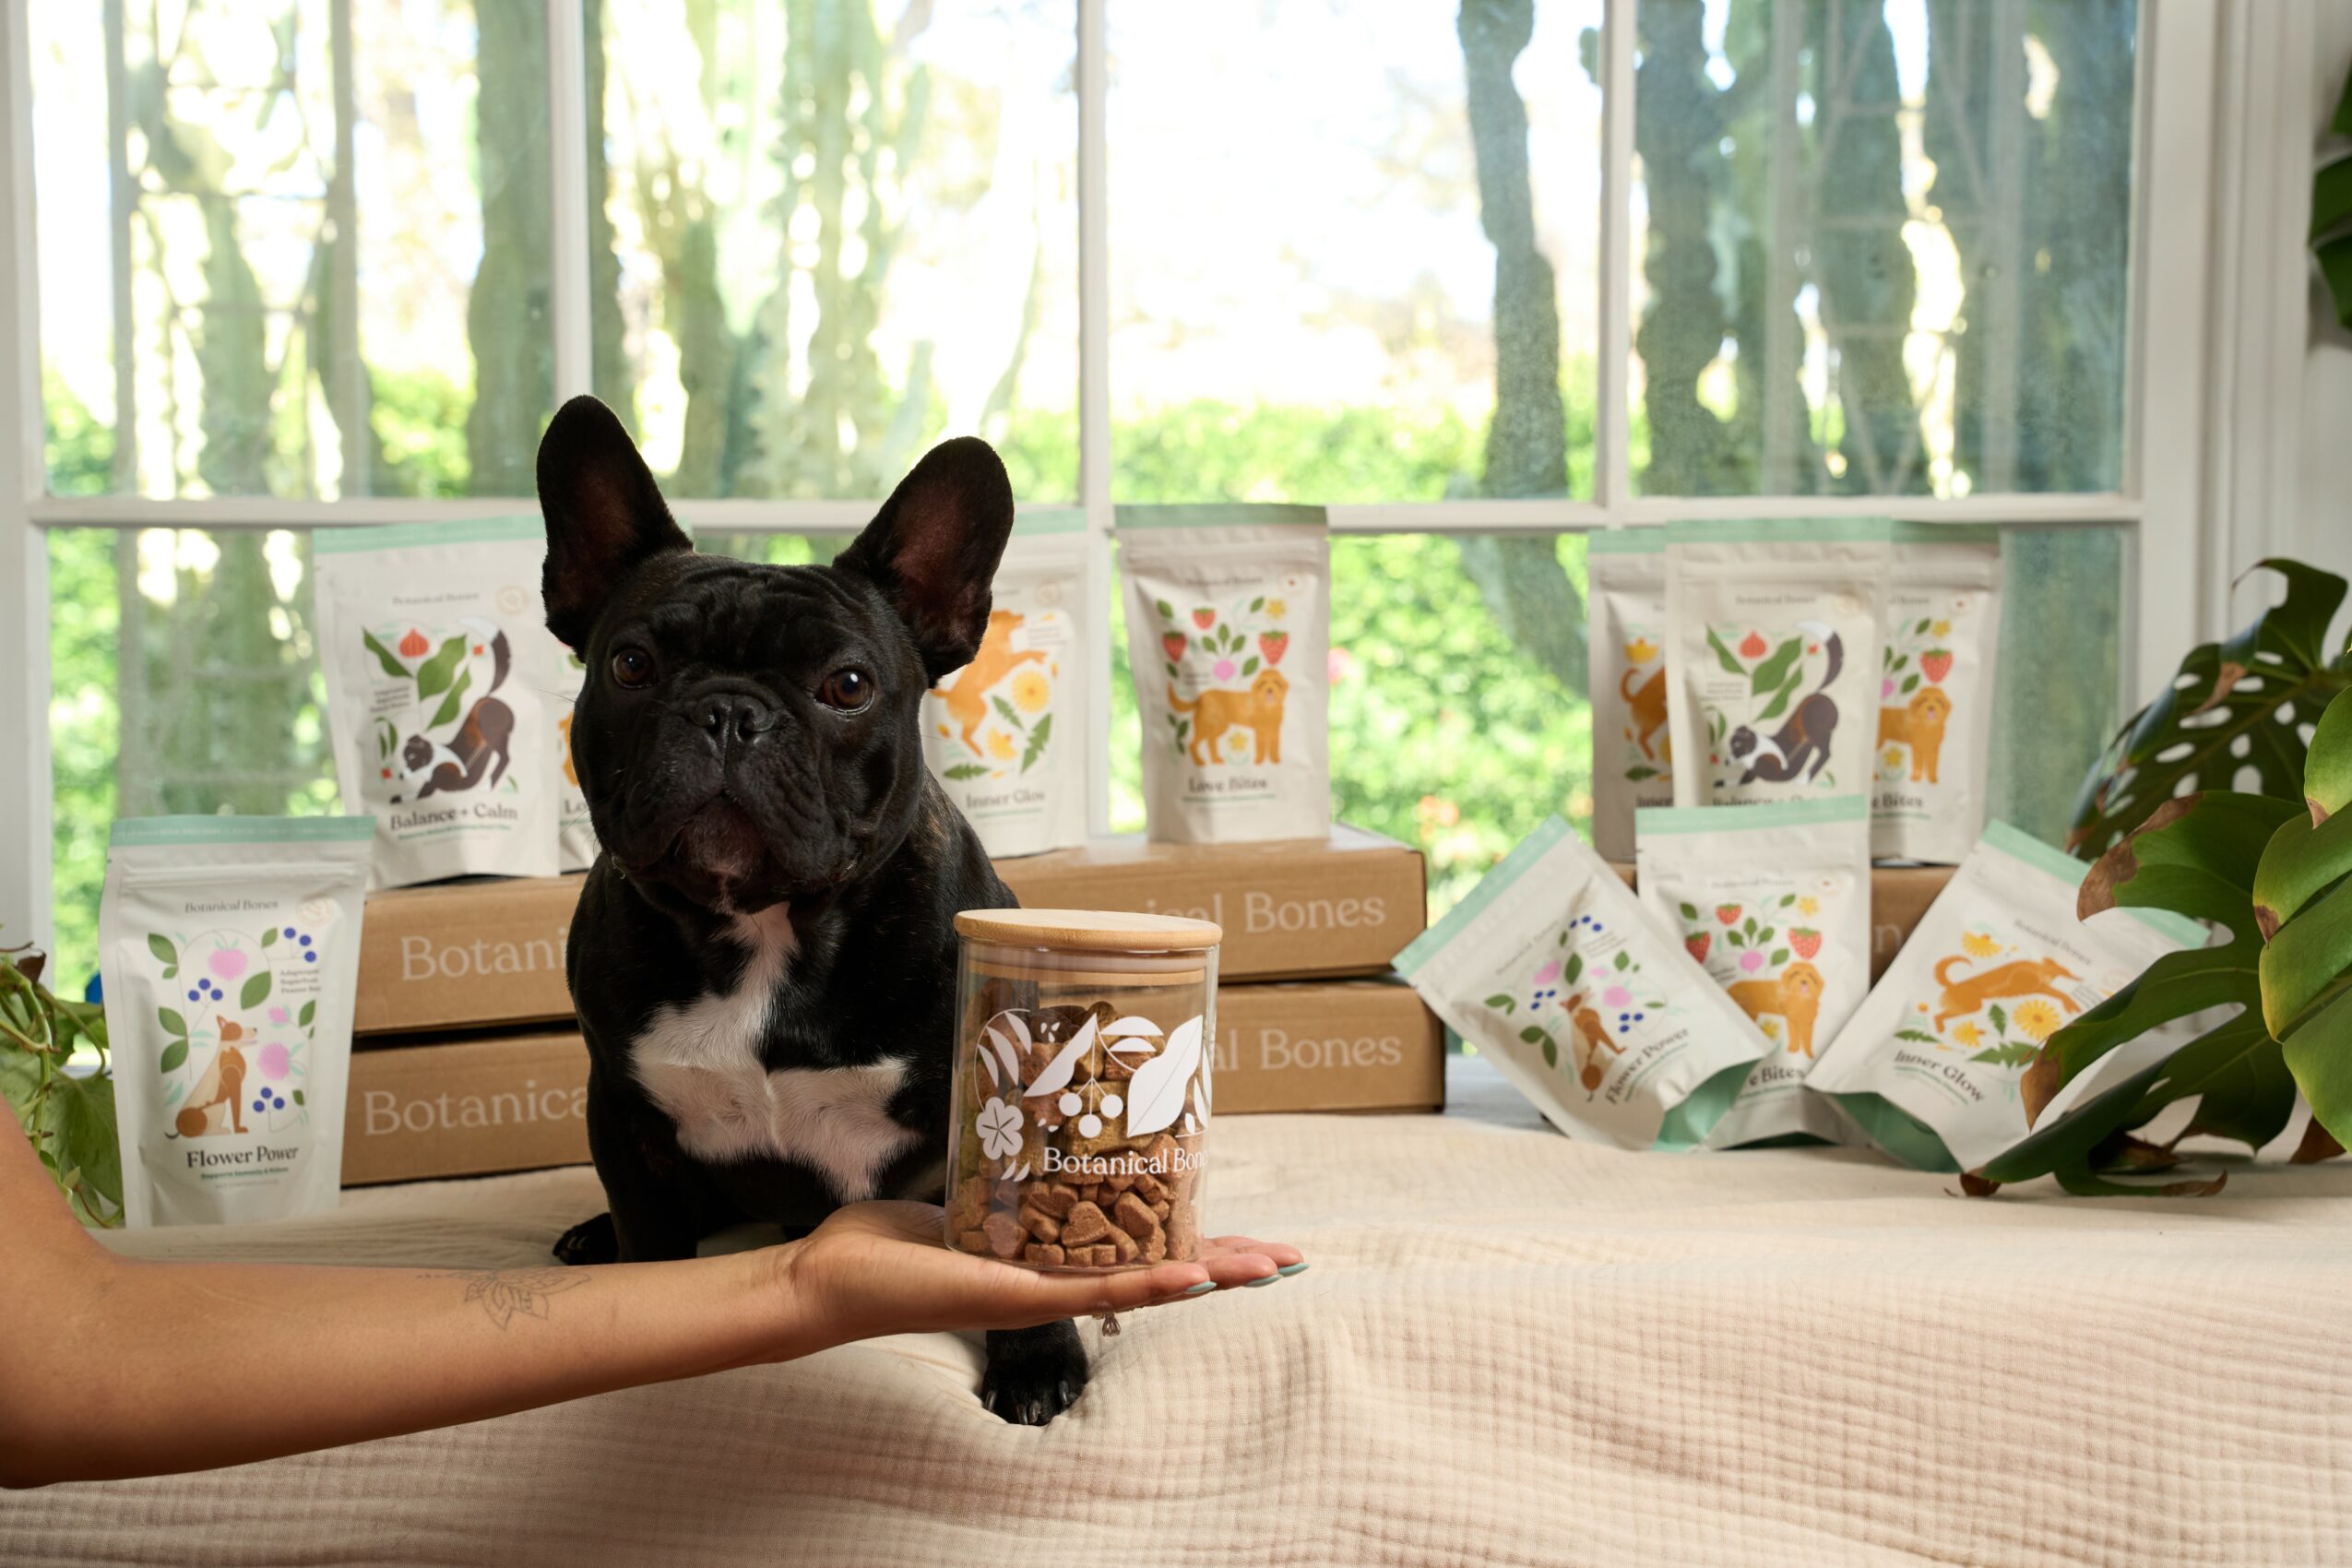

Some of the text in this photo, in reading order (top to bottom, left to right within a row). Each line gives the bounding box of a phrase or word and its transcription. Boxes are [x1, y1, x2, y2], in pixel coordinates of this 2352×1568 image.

[1883, 791, 1925, 809] Bites
[390, 809, 457, 830] Balance
[474, 802, 517, 819] Calm
[184, 899, 279, 913] Botanical Bones
[1244, 891, 1386, 933] Bones
[1260, 1028, 1402, 1071] Bones
[1605, 1028, 1688, 1105] Flower Power
[1895, 1051, 1942, 1068] Inner
[1943, 1065, 1985, 1101] Glow
[186, 1145, 299, 1169] Flower Power
[1043, 1146, 1168, 1175] Botanical
